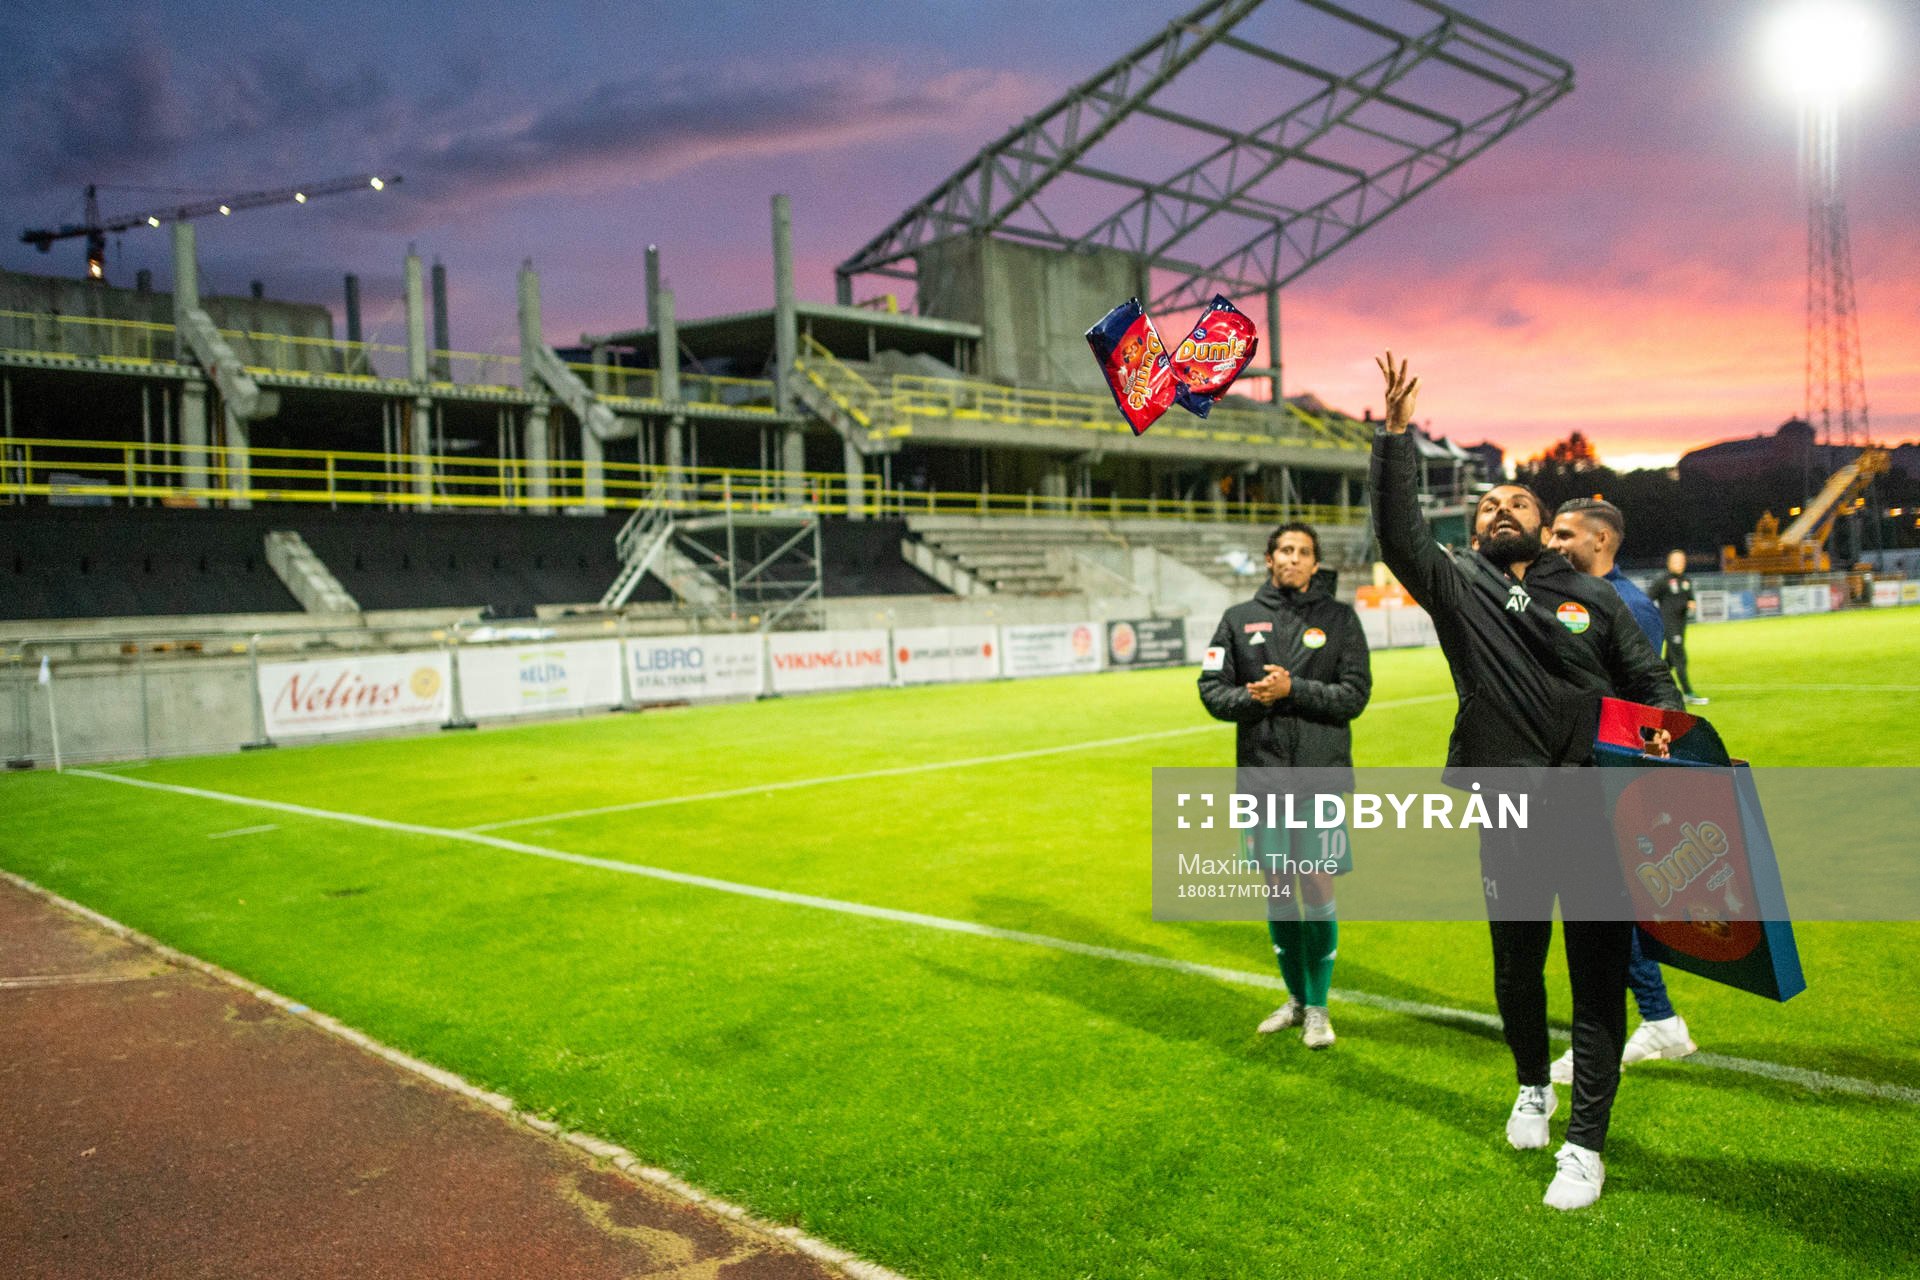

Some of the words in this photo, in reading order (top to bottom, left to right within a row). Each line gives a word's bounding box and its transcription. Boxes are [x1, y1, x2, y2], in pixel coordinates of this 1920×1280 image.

[1175, 337, 1247, 363] Dumle
[1127, 331, 1163, 411] Dumle
[1505, 595, 1531, 612] AV
[774, 651, 841, 669] VIKING
[846, 648, 881, 666] LINE
[273, 670, 402, 714] Nelins
[1317, 829, 1346, 860] 10
[1635, 821, 1729, 907] Dumle
[1483, 876, 1498, 899] 21
